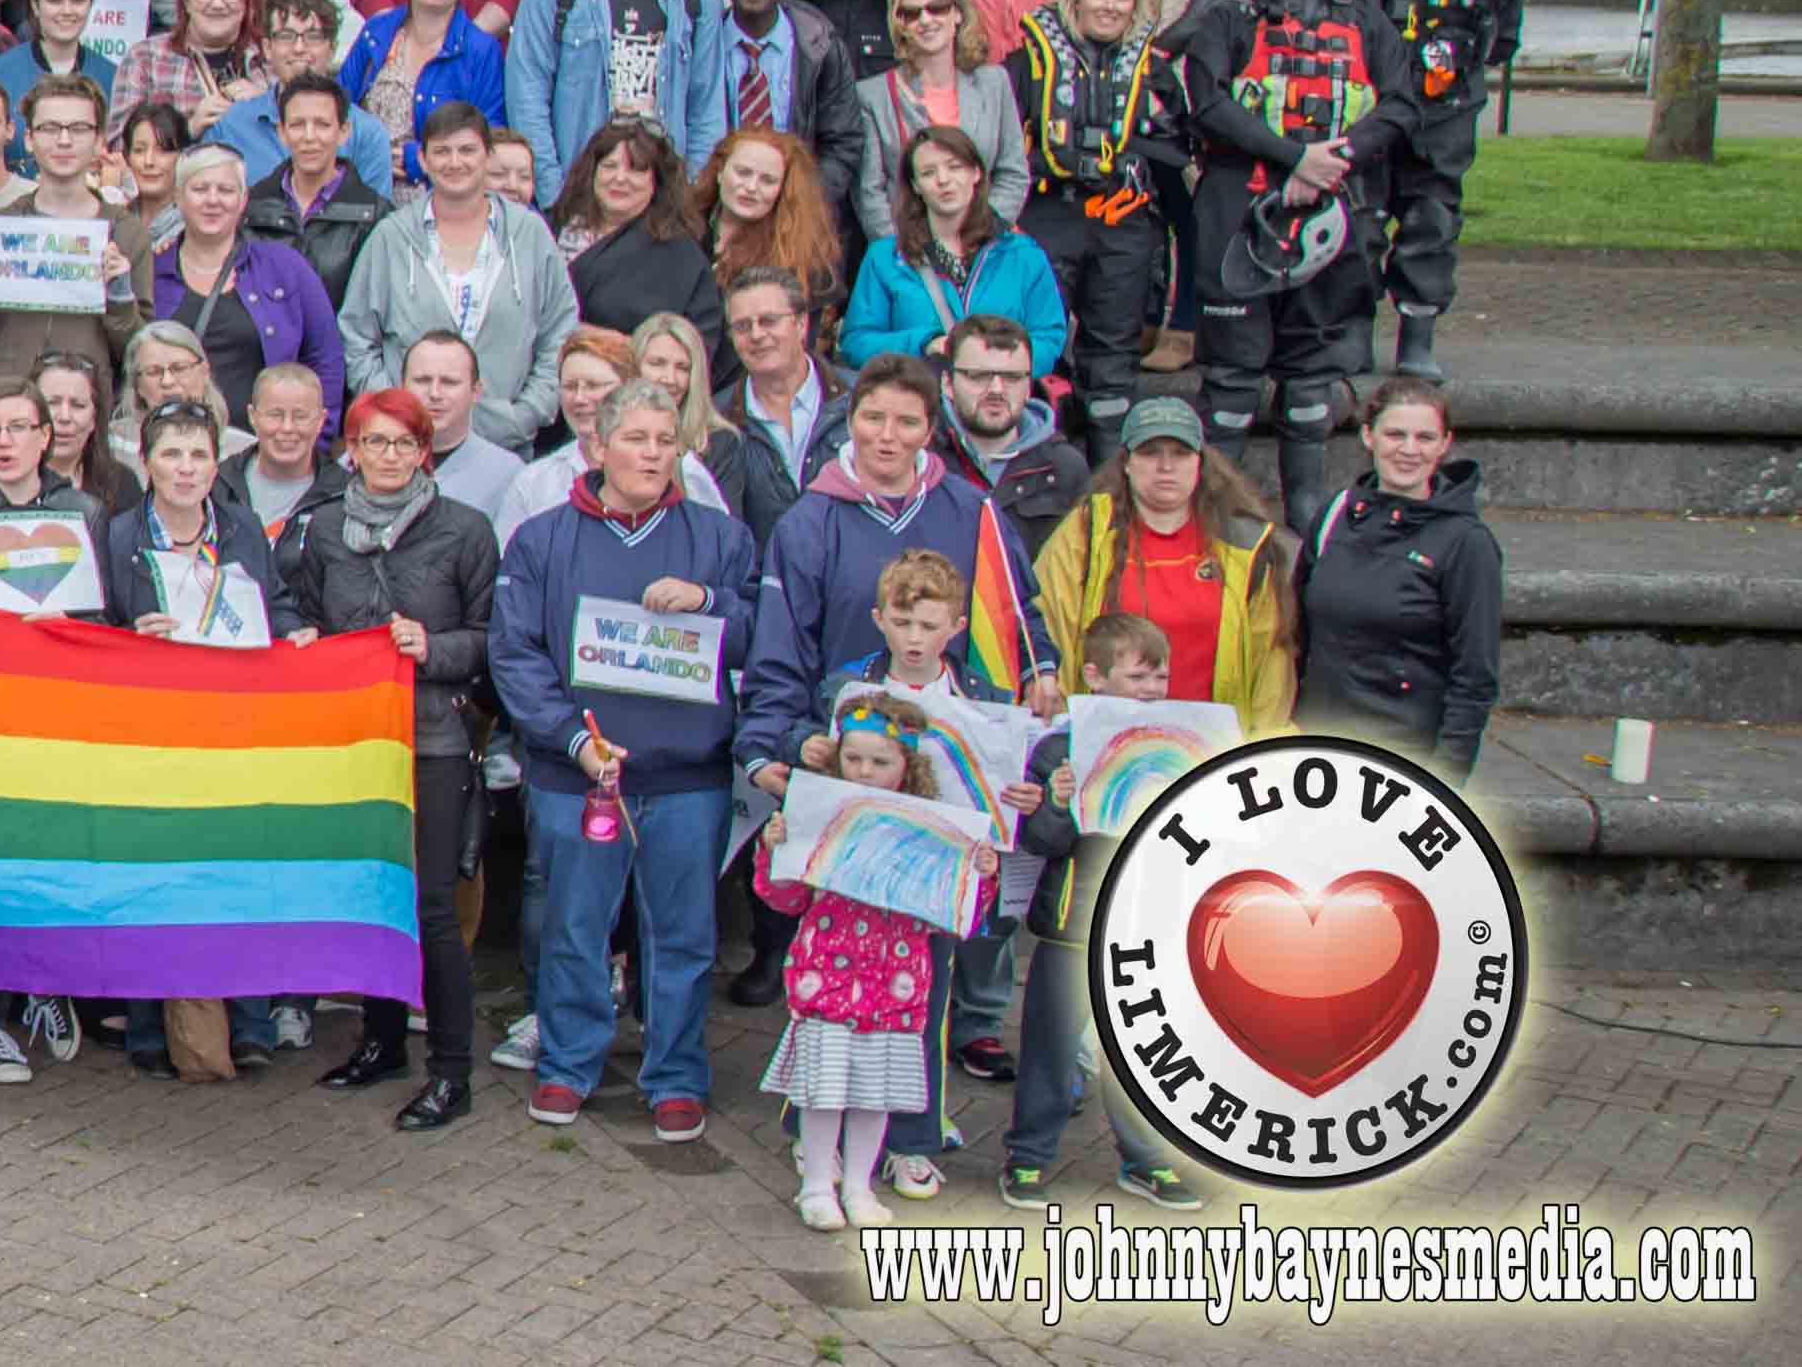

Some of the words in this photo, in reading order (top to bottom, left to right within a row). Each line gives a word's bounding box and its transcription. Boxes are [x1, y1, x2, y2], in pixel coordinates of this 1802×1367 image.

[92, 10, 126, 26] ARE
[0, 233, 39, 252] WE
[42, 233, 92, 255] ARE
[595, 617, 638, 644] WE
[642, 624, 701, 653] ARE
[578, 643, 712, 683] ORLANDO
